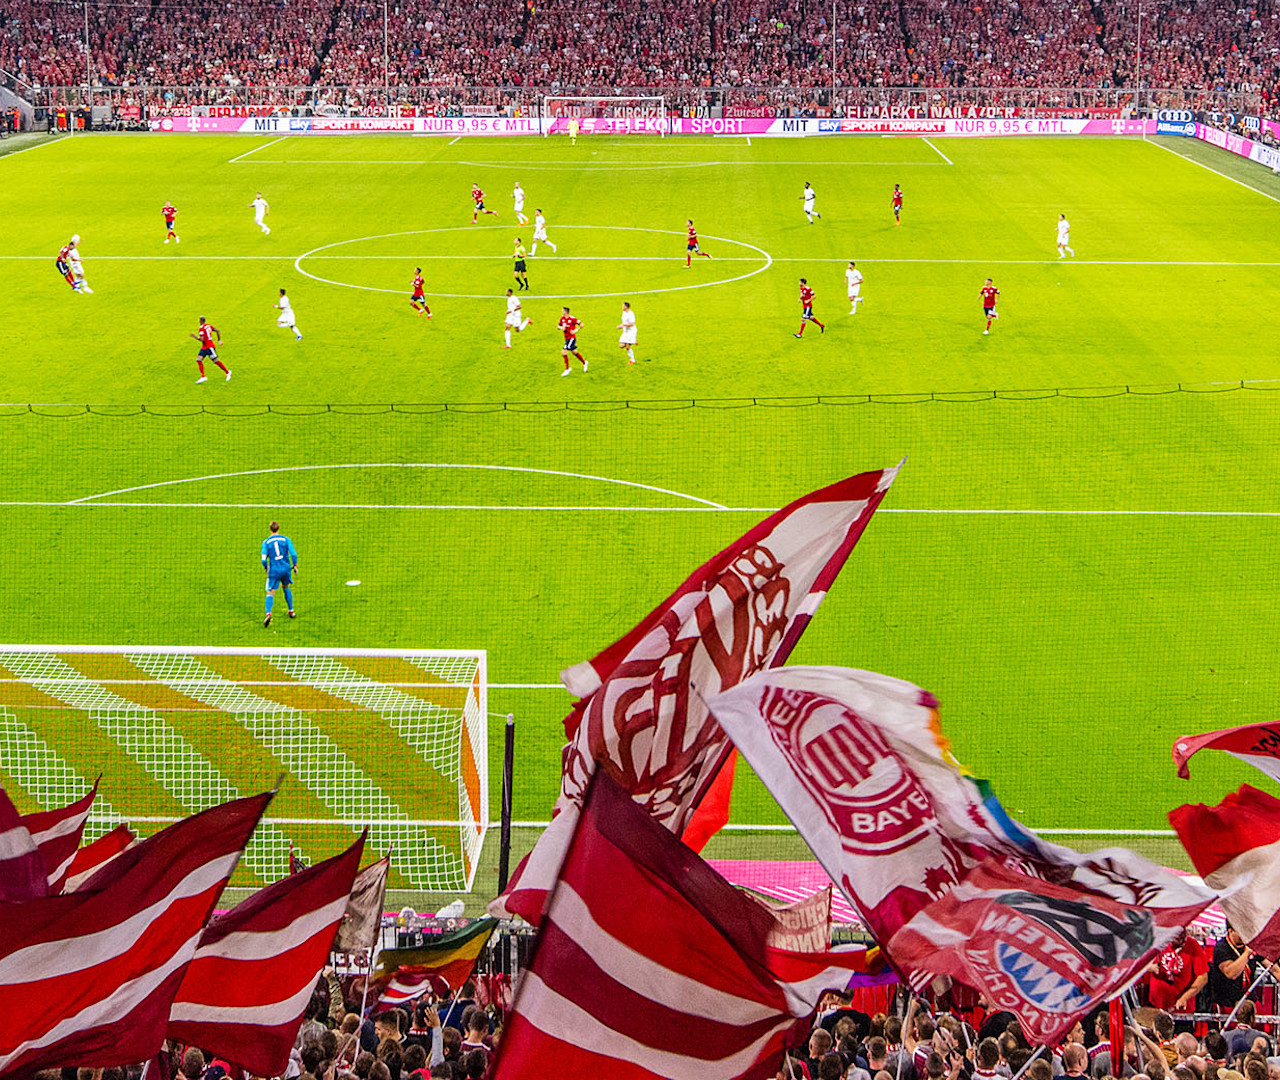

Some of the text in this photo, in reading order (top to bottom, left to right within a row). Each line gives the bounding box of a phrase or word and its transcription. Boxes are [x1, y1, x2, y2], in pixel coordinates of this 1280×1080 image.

[614, 107, 669, 118] KIRCHZEL
[255, 119, 280, 130] MIT
[290, 120, 310, 131] sky
[423, 120, 539, 132] NUR 9,95 € MTL.
[691, 120, 745, 133] SPORT
[783, 120, 808, 131] MIT
[820, 121, 840, 132] sky
[954, 121, 1072, 134] NUR 9,95 € MTL.
[1157, 123, 1186, 133] Allianz
[274, 541, 283, 560] 1
